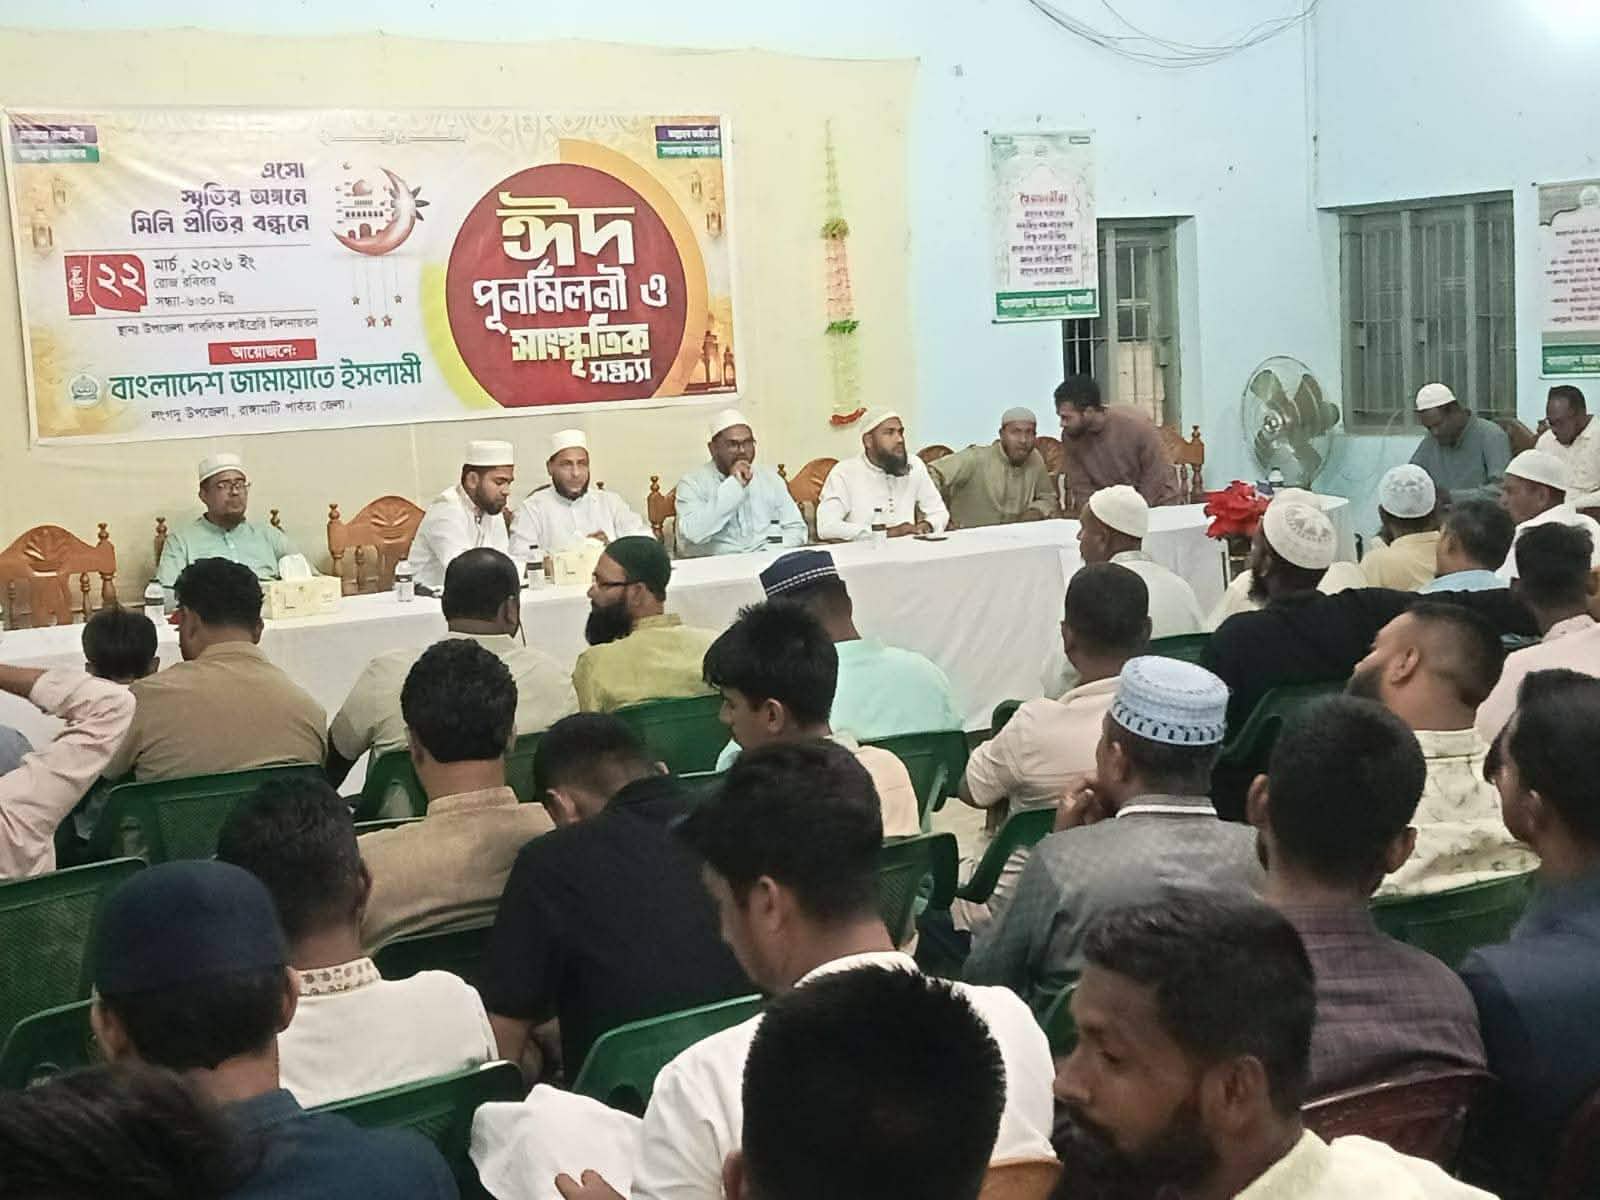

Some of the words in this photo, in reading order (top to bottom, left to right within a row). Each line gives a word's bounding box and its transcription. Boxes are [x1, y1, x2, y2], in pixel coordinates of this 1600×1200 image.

[261, 162, 305, 179] এসো
[131, 210, 174, 234] মিলি
[183, 208, 243, 234] প্রীতির
[253, 214, 309, 235] বন্ধনে
[496, 191, 635, 266] ঈদ
[191, 257, 233, 273] ২০২৬
[240, 254, 257, 271] ইং
[96, 263, 145, 298] ২২
[640, 274, 668, 307] ও
[109, 371, 224, 400] বাংলাদেশ
[229, 365, 335, 394] জামায়াতে
[340, 353, 422, 389] ইসলামী
